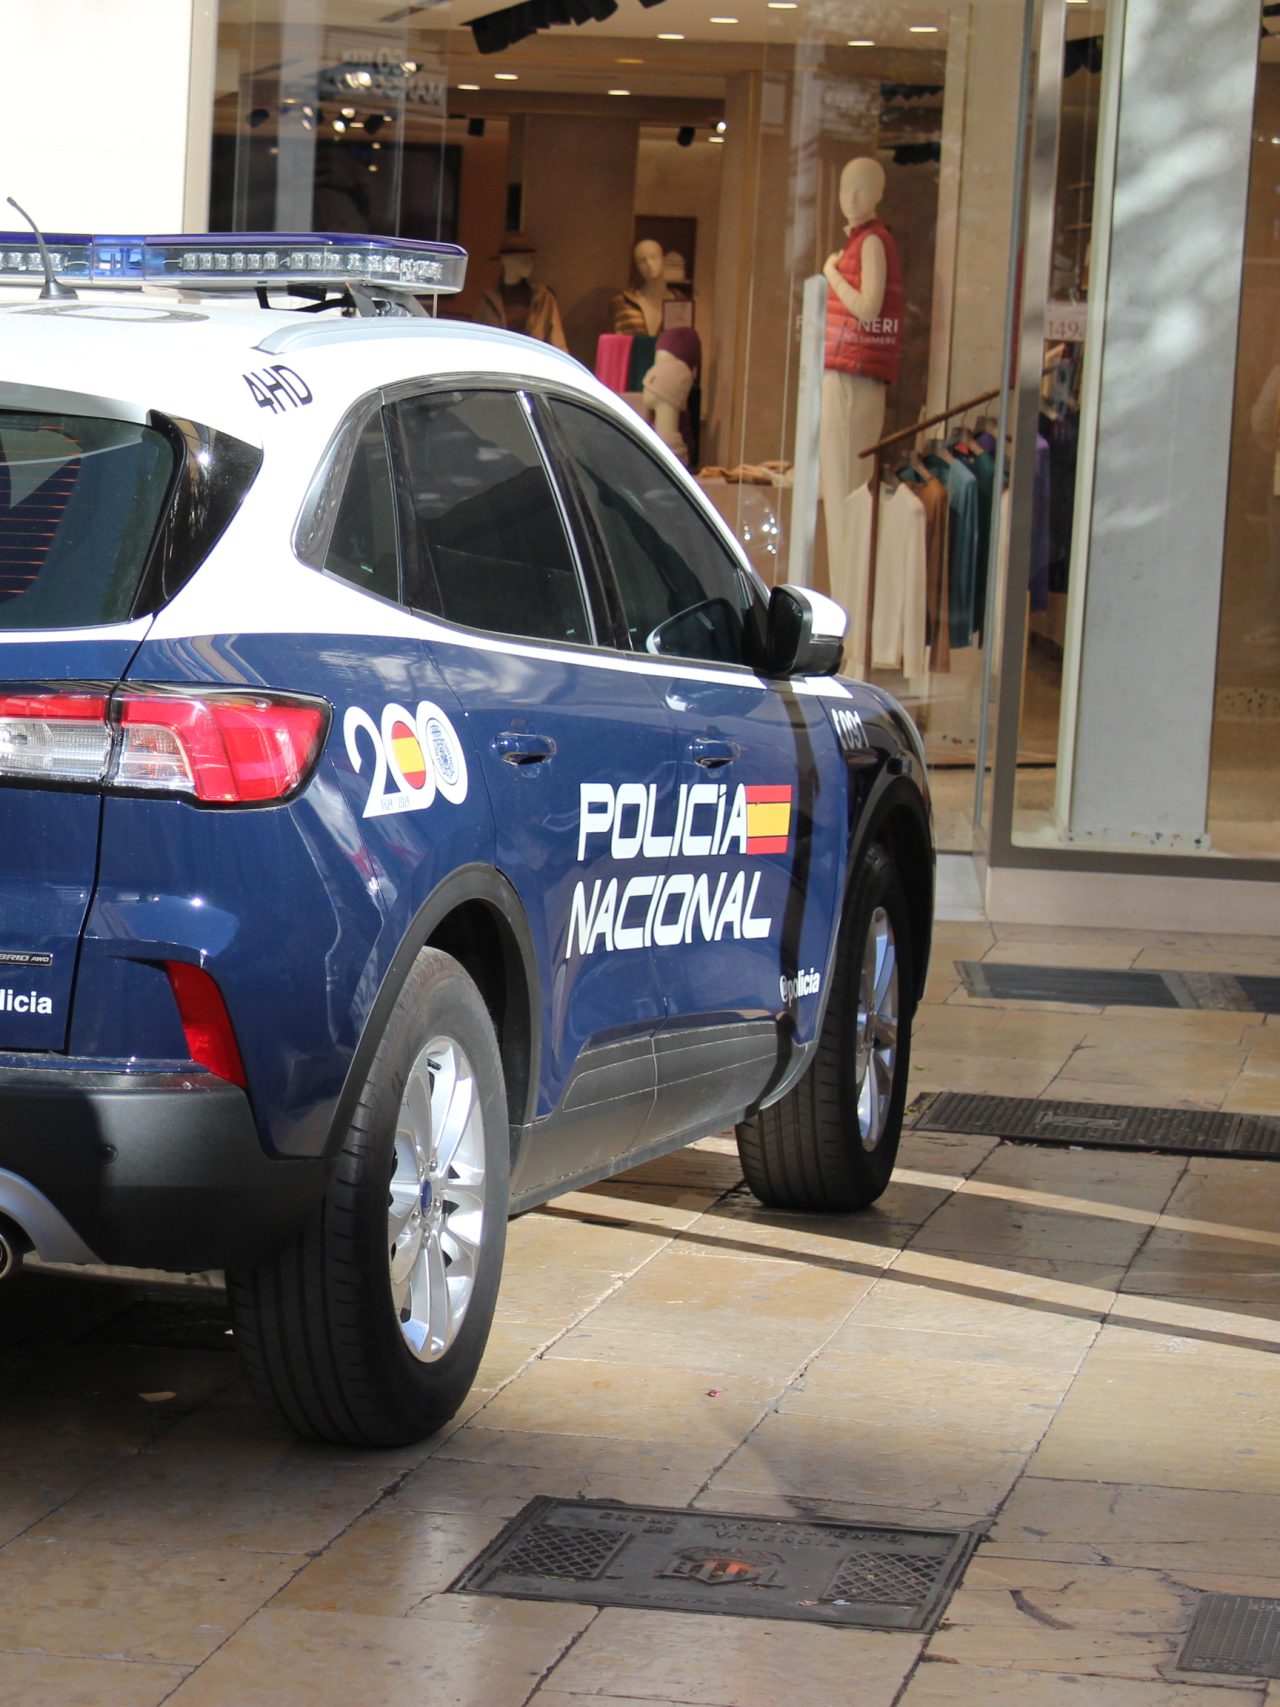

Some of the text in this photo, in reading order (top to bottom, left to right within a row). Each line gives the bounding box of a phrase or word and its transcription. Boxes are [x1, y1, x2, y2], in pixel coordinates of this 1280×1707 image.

[242, 365, 312, 414] 4HD
[343, 700, 468, 818] 200
[565, 870, 772, 959] NACIONAL
[779, 967, 821, 1008] @policia
